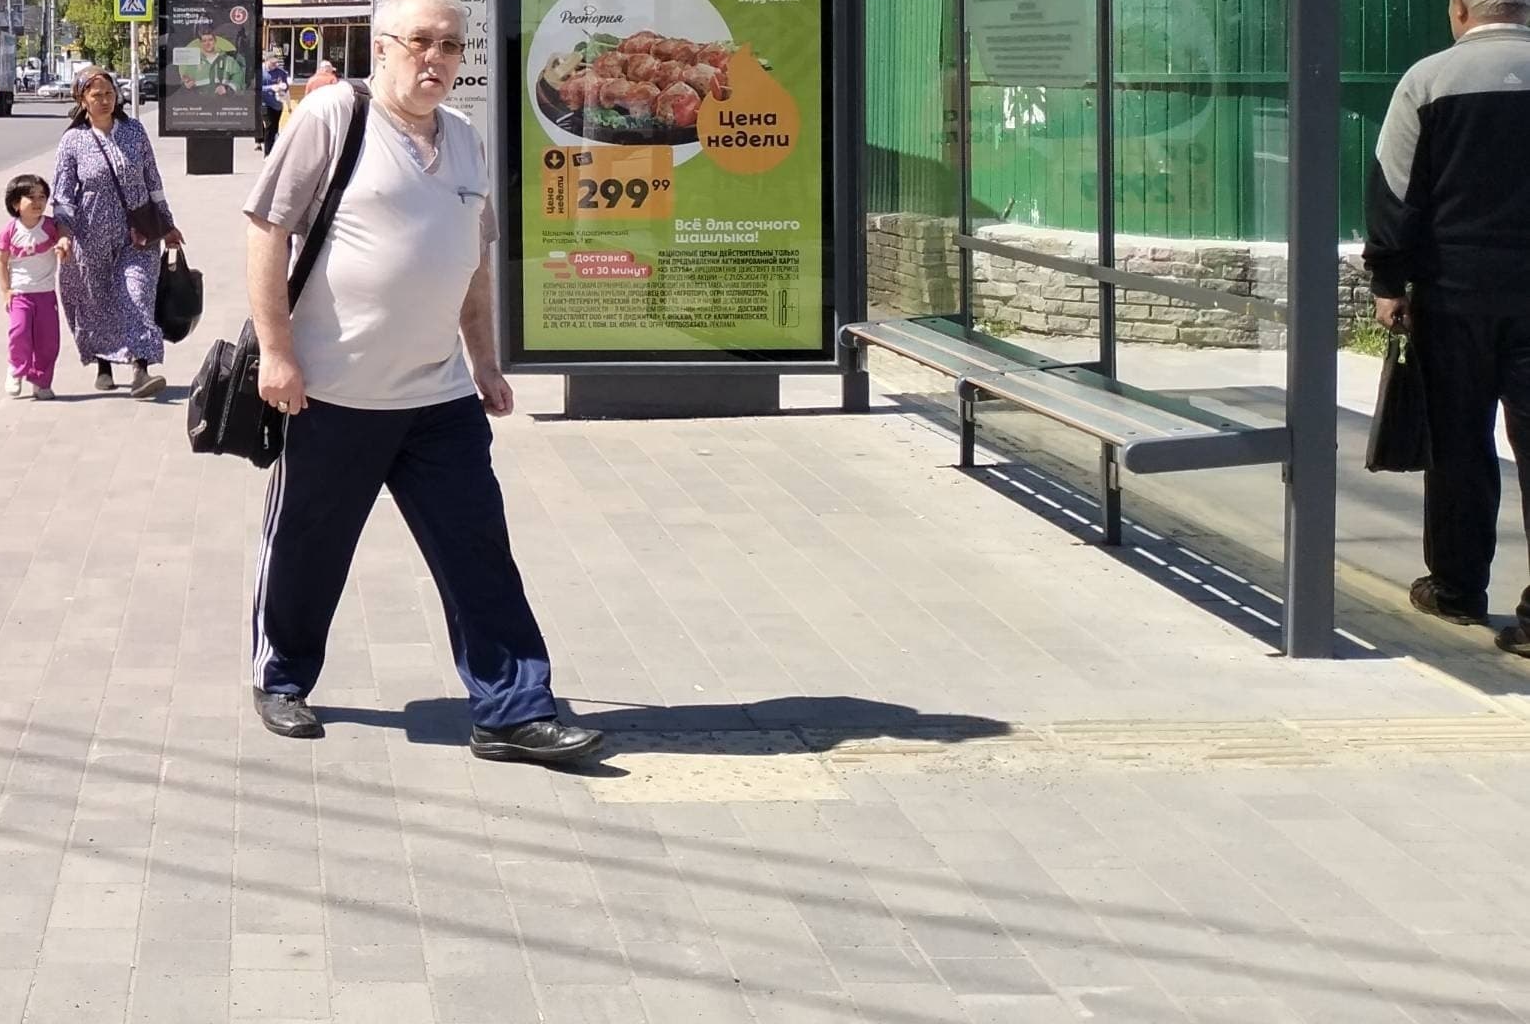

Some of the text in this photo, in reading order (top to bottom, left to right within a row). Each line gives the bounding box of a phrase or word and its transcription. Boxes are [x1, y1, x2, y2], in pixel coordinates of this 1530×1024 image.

[560, 10, 624, 27] Рестория
[719, 110, 777, 127] Цена
[707, 131, 790, 148] недели
[546, 187, 554, 214] Цена
[577, 178, 670, 209] 299 99
[675, 218, 800, 232] Всё для сочного
[675, 231, 759, 244] шашлыка!
[574, 253, 627, 264] Доставка
[581, 266, 647, 277] от 30 минут
